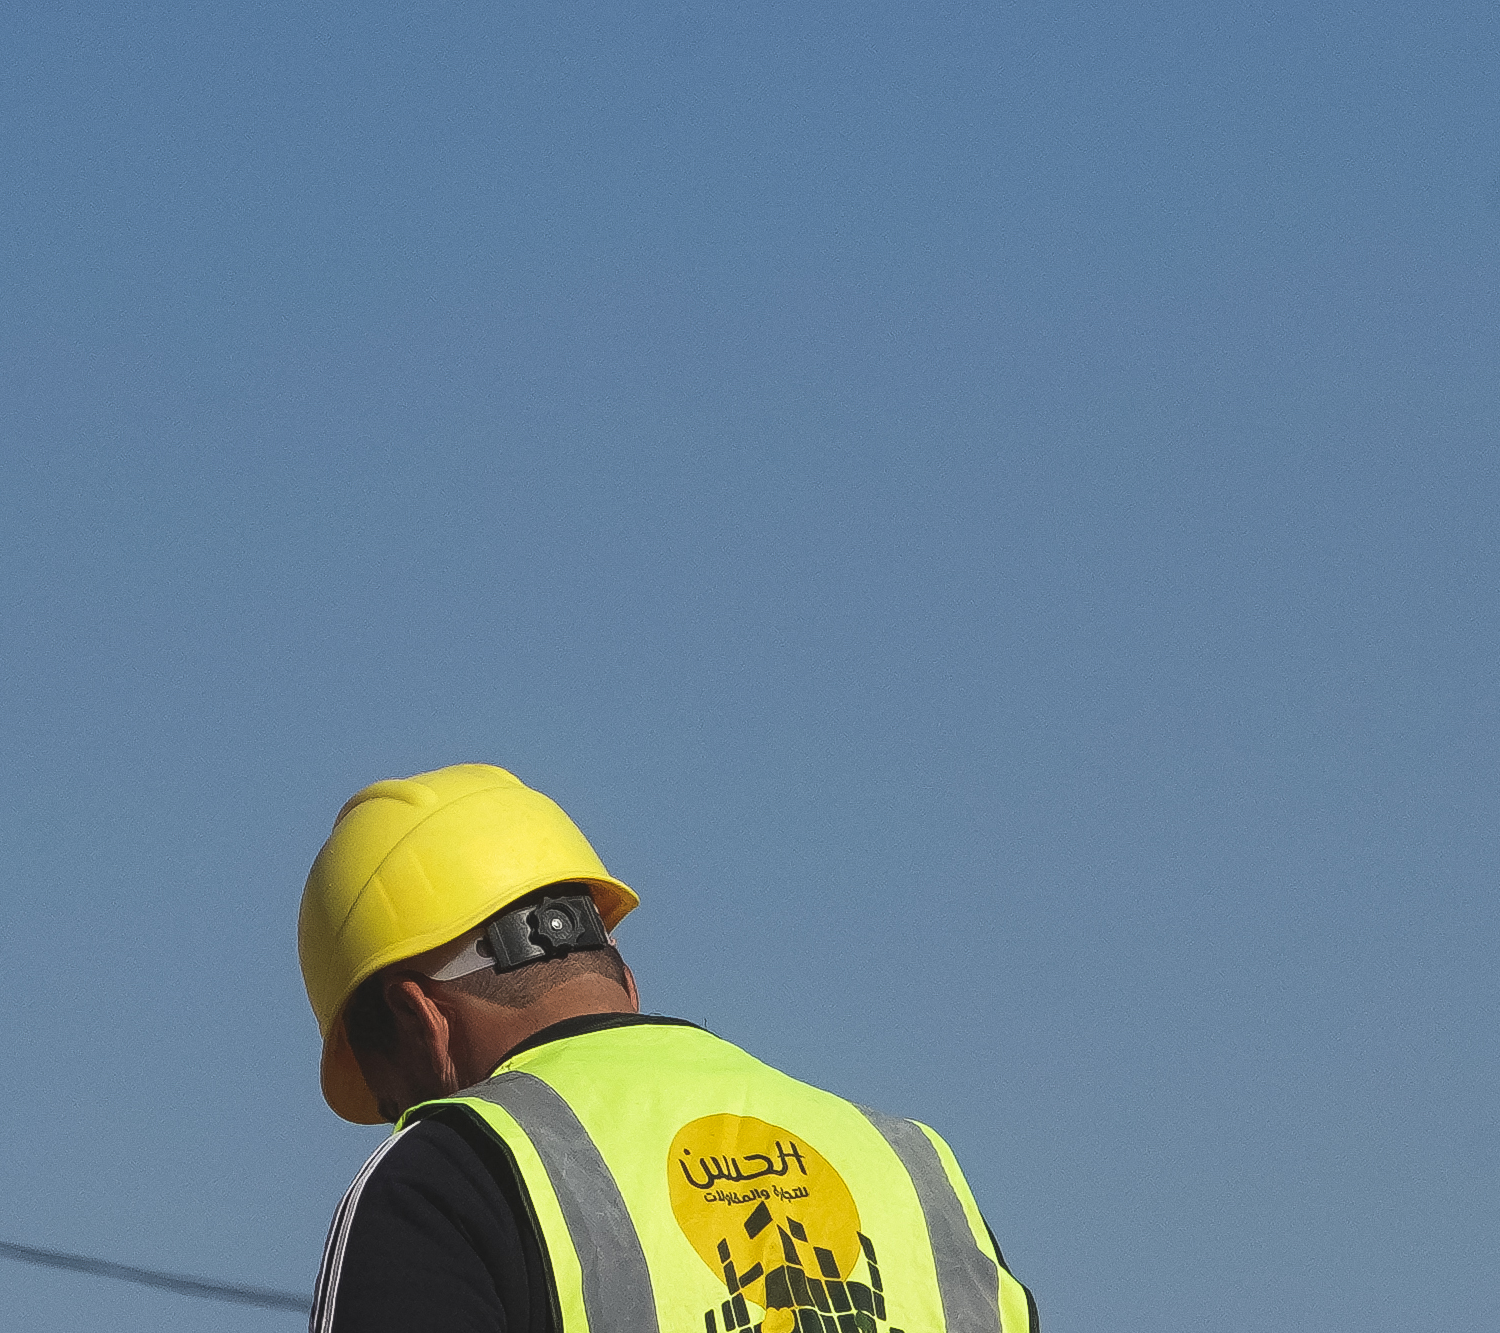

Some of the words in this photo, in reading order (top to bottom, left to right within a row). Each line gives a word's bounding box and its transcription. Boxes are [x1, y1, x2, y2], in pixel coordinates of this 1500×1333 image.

[678, 1140, 808, 1189] الحسن
[703, 1188, 771, 1206] والمقاولات
[771, 1184, 810, 1203] للتجارة
